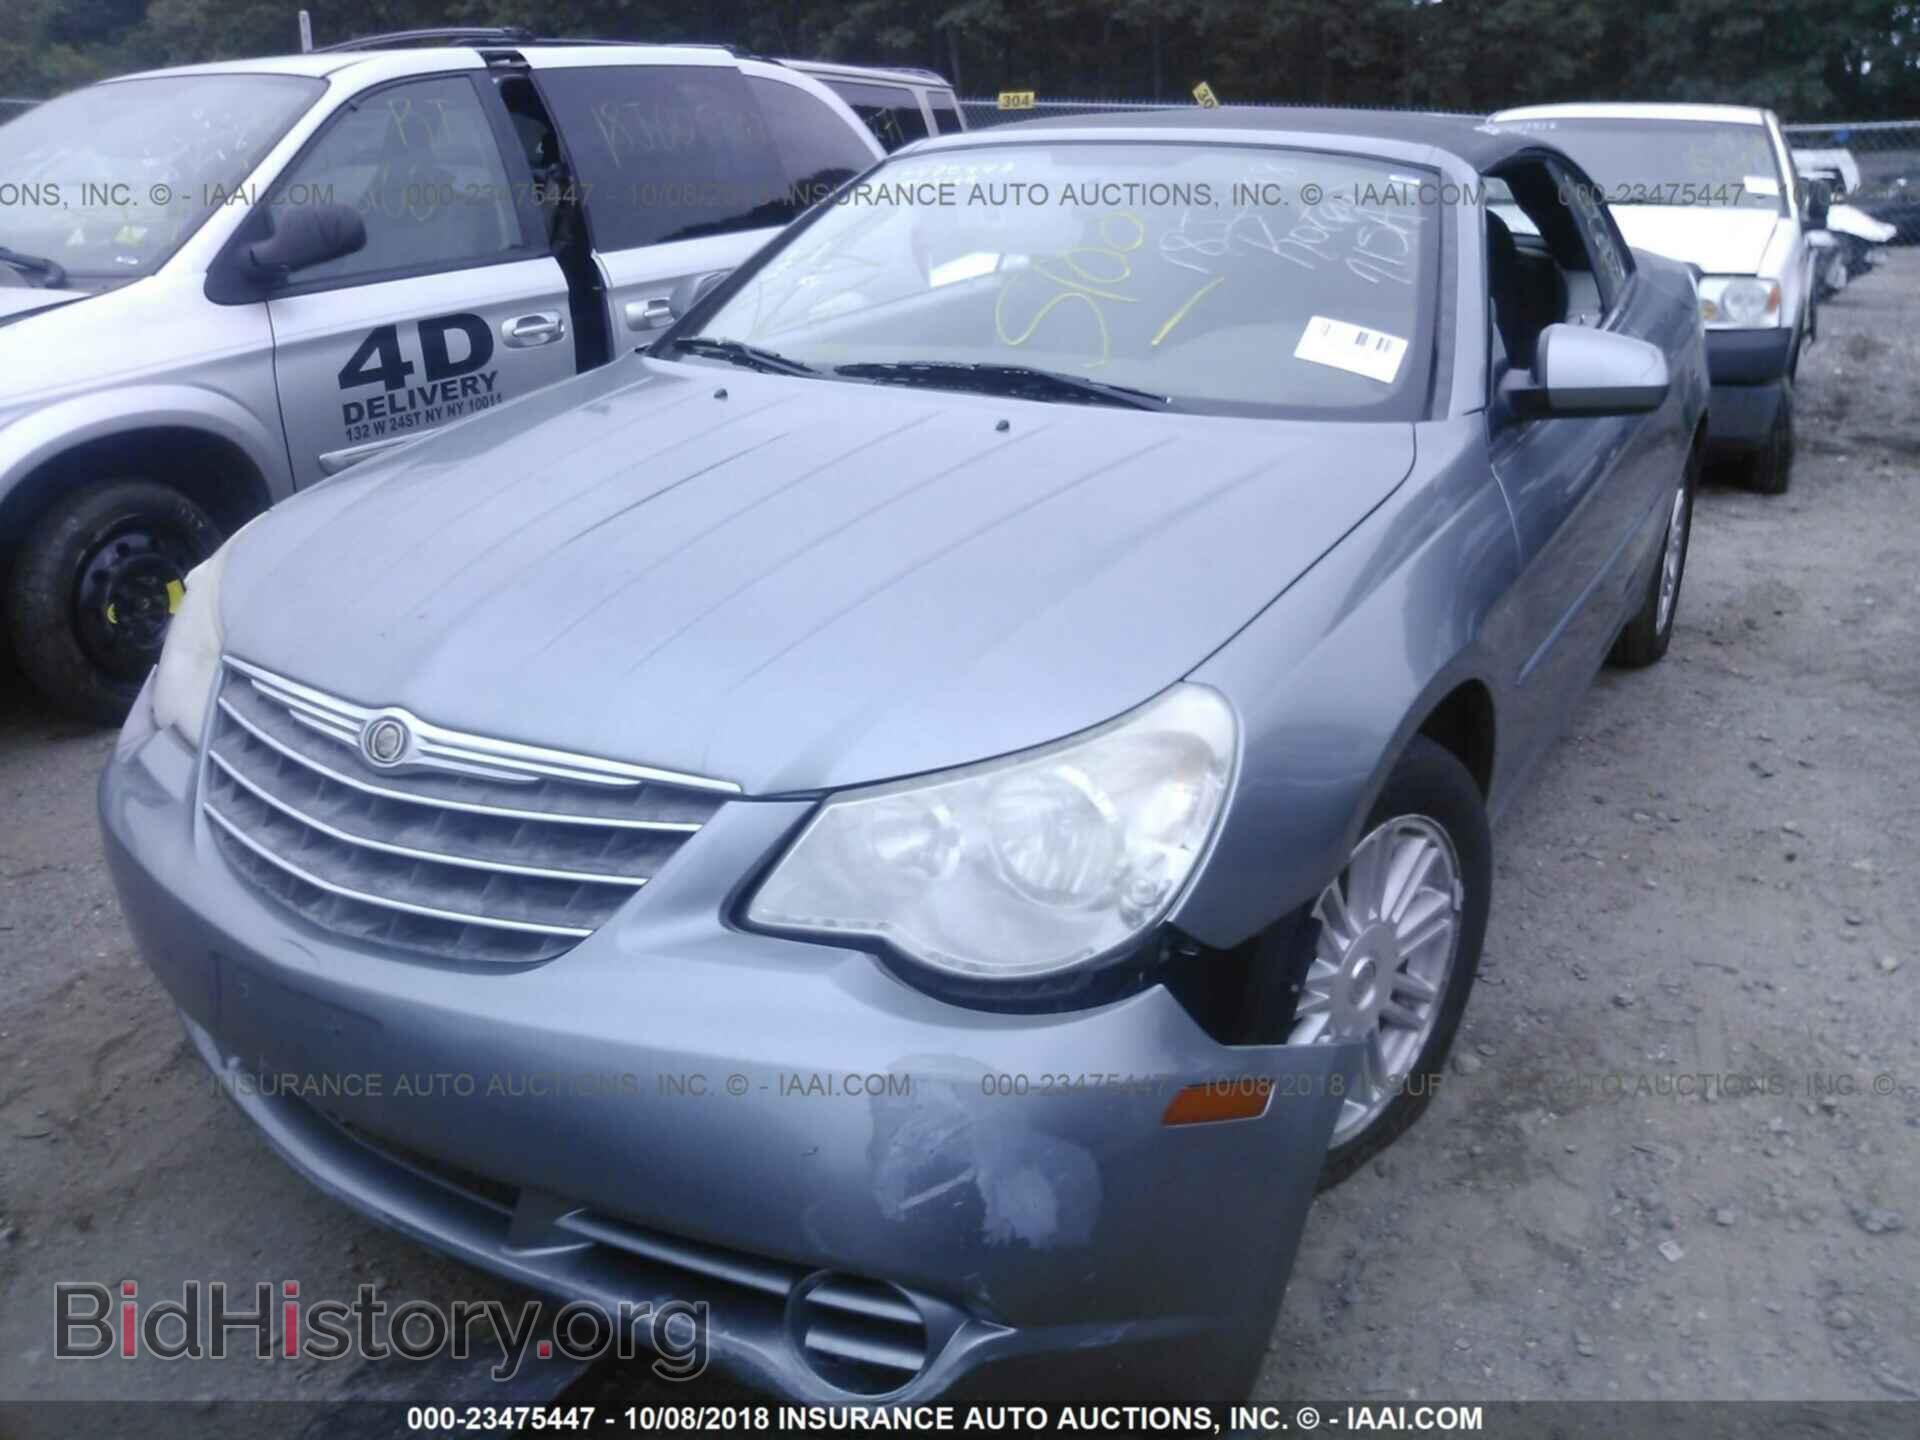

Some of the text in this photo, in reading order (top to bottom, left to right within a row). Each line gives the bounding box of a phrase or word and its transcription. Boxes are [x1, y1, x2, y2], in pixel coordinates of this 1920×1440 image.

[1002, 94, 1030, 109] 304
[337, 312, 494, 392] 4D
[342, 370, 498, 426] DELIVERY
[346, 424, 370, 442] 132
[373, 420, 385, 436] W
[390, 411, 421, 431] 24ST
[425, 408, 442, 424] NY
[447, 400, 464, 417] NY
